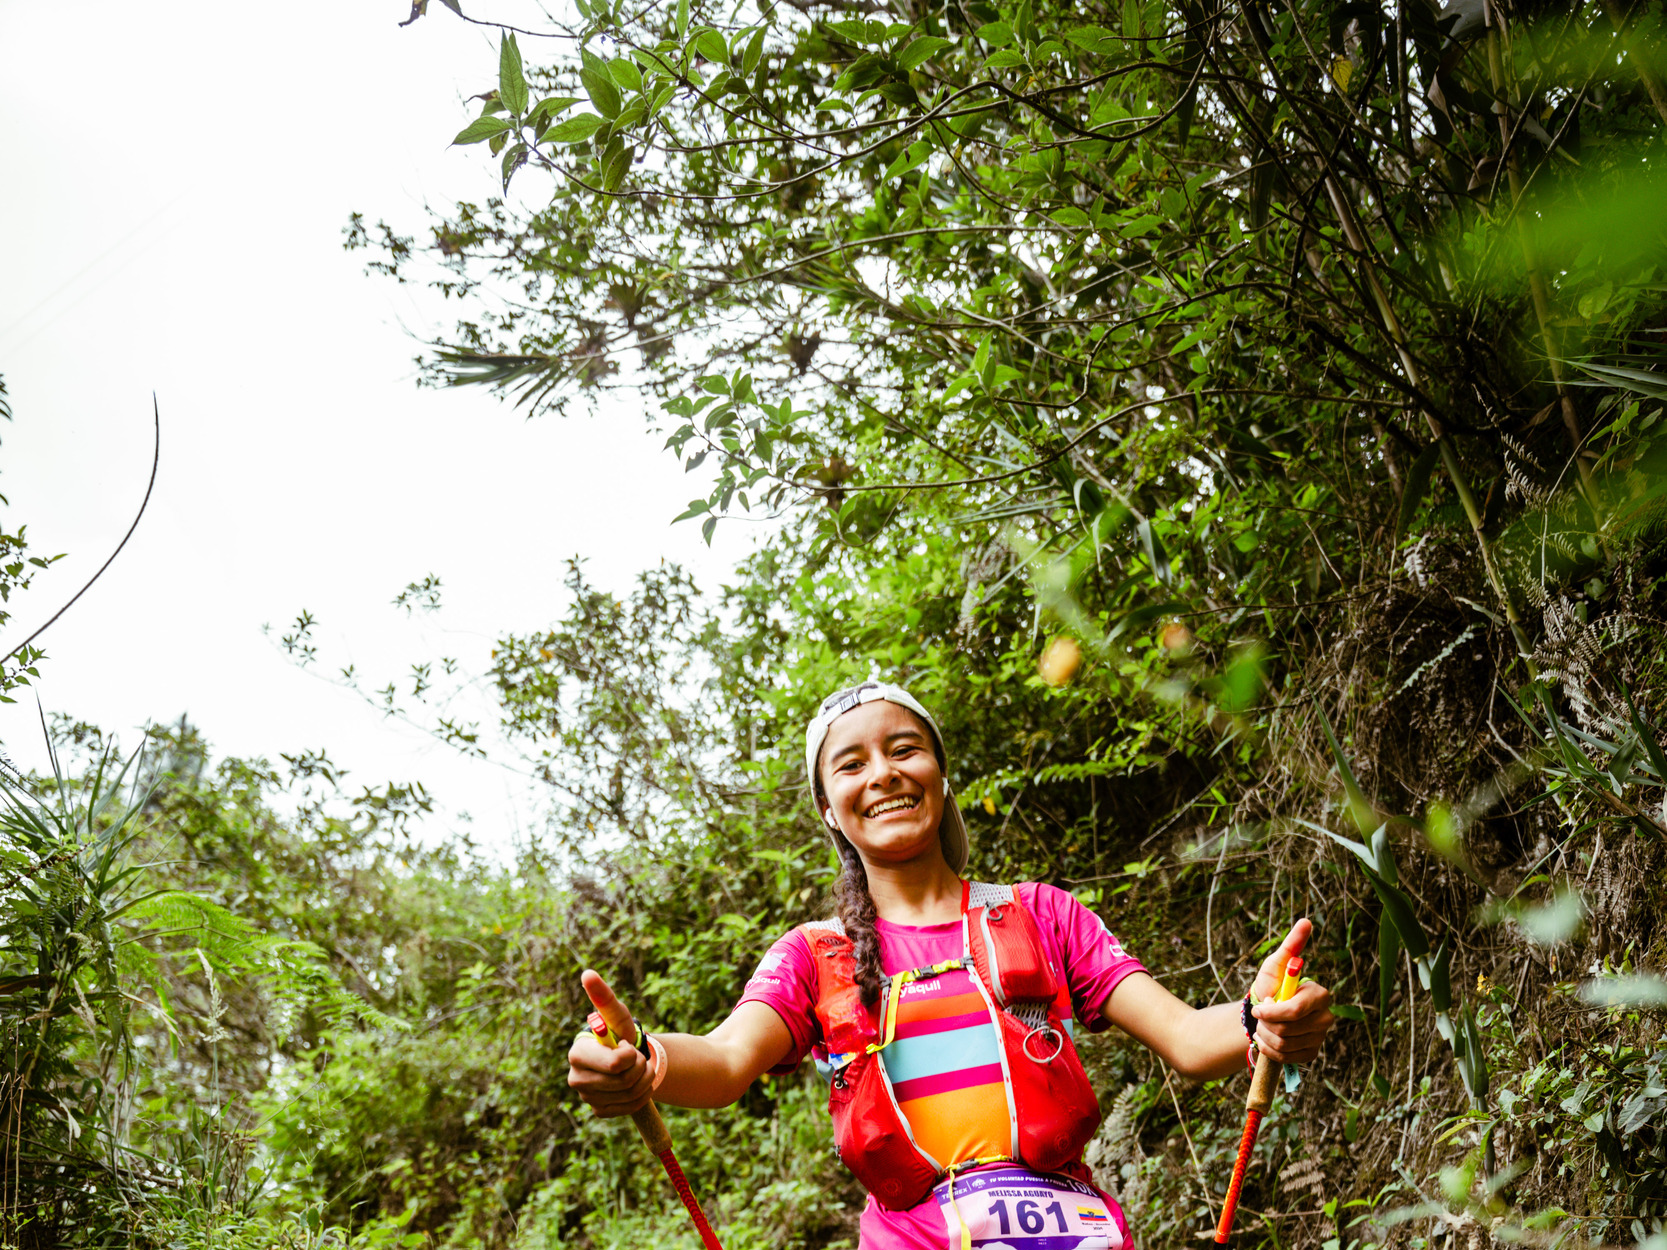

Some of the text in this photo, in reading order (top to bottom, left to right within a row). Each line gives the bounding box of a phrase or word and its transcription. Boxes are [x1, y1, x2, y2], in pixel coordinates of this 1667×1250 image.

[942, 1187, 968, 1200] TEREX
[988, 1190, 1054, 1199] MELISSA AGUAYO
[988, 1199, 1069, 1235] 161
